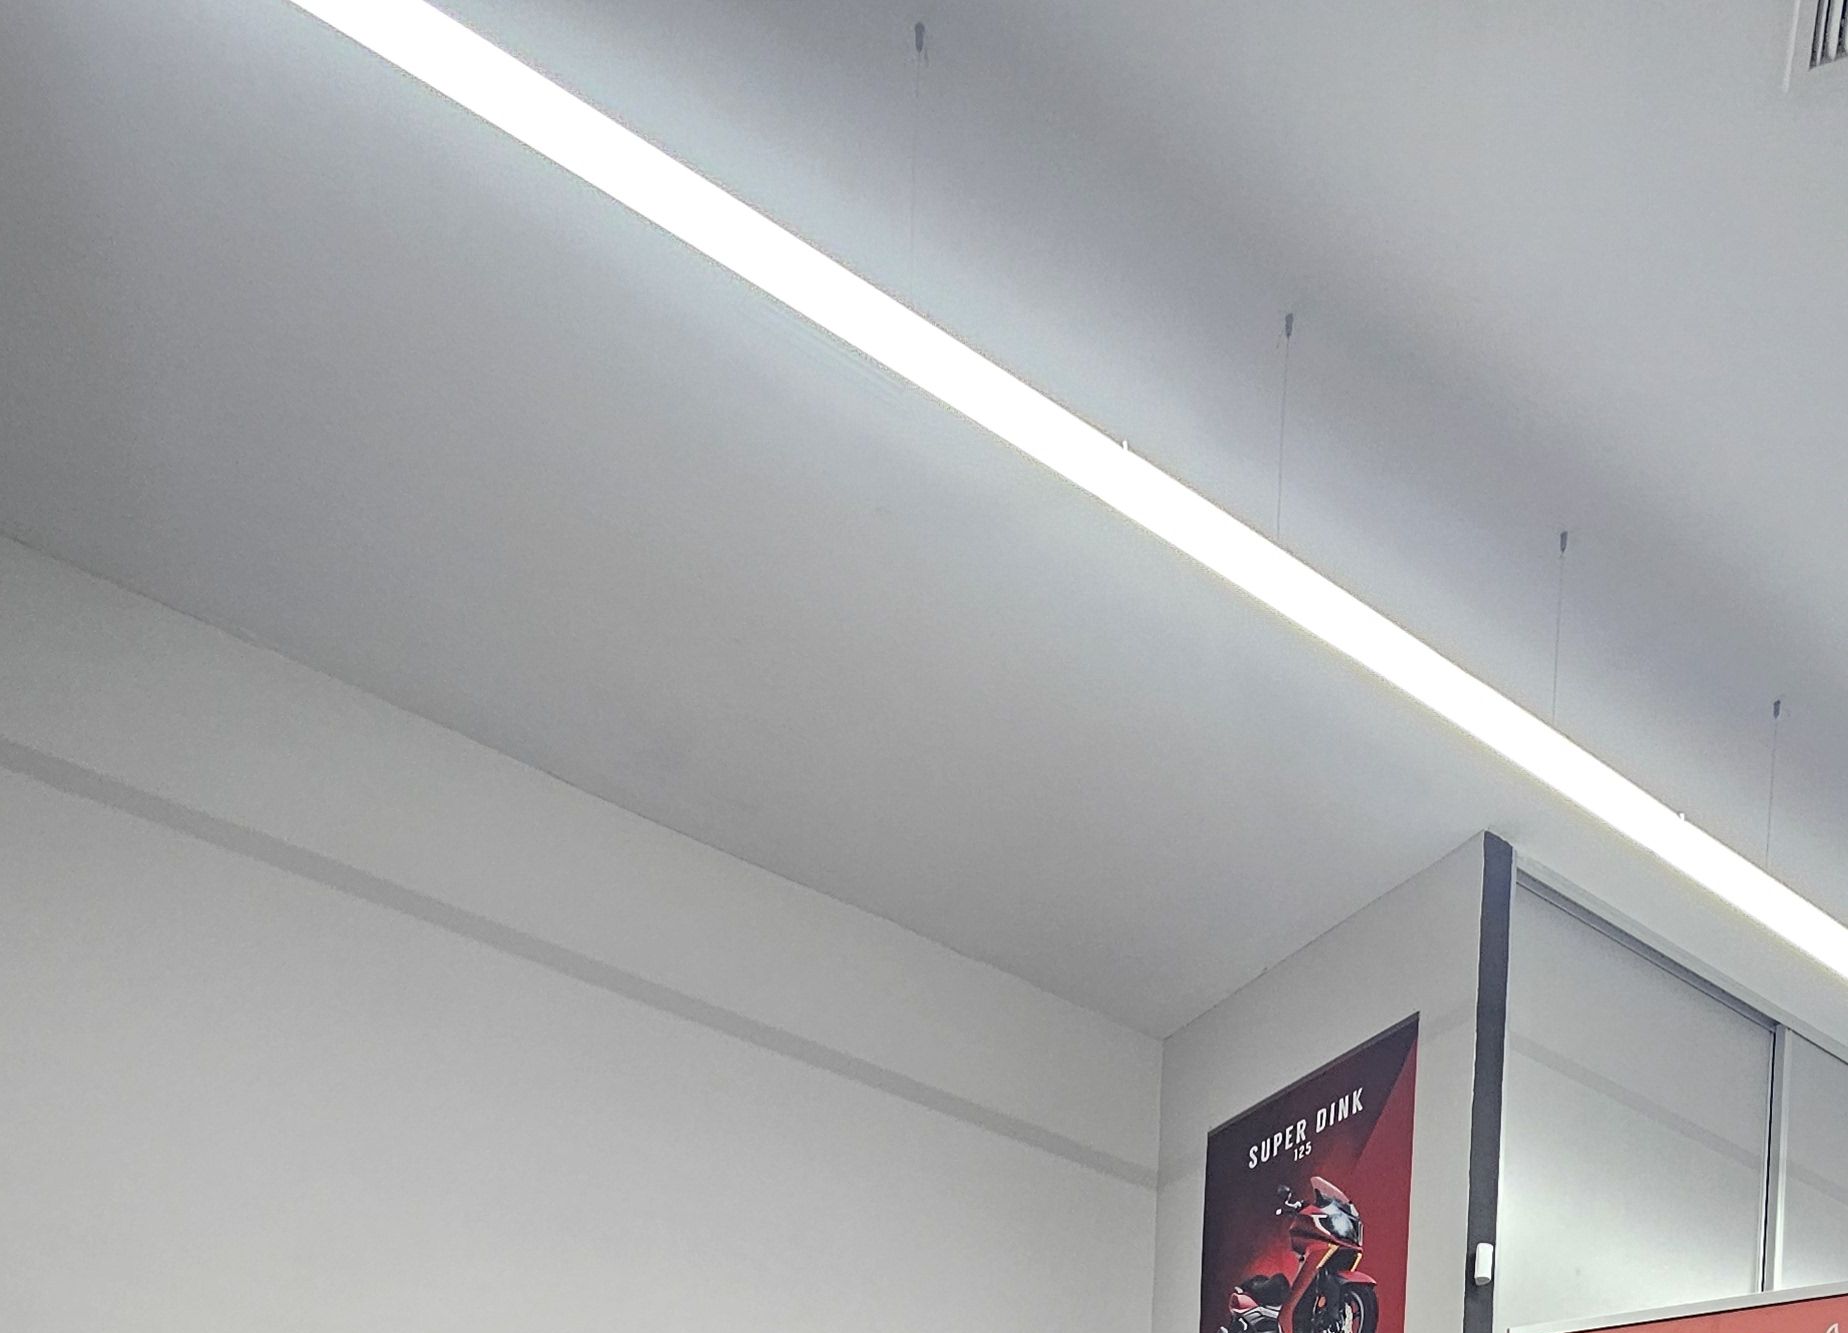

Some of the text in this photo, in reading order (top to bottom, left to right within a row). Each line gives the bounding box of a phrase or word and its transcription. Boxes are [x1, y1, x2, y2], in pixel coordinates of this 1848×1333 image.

[1248, 1087, 1363, 1169] SUPER DINK
[1293, 1140, 1312, 1161] 125
